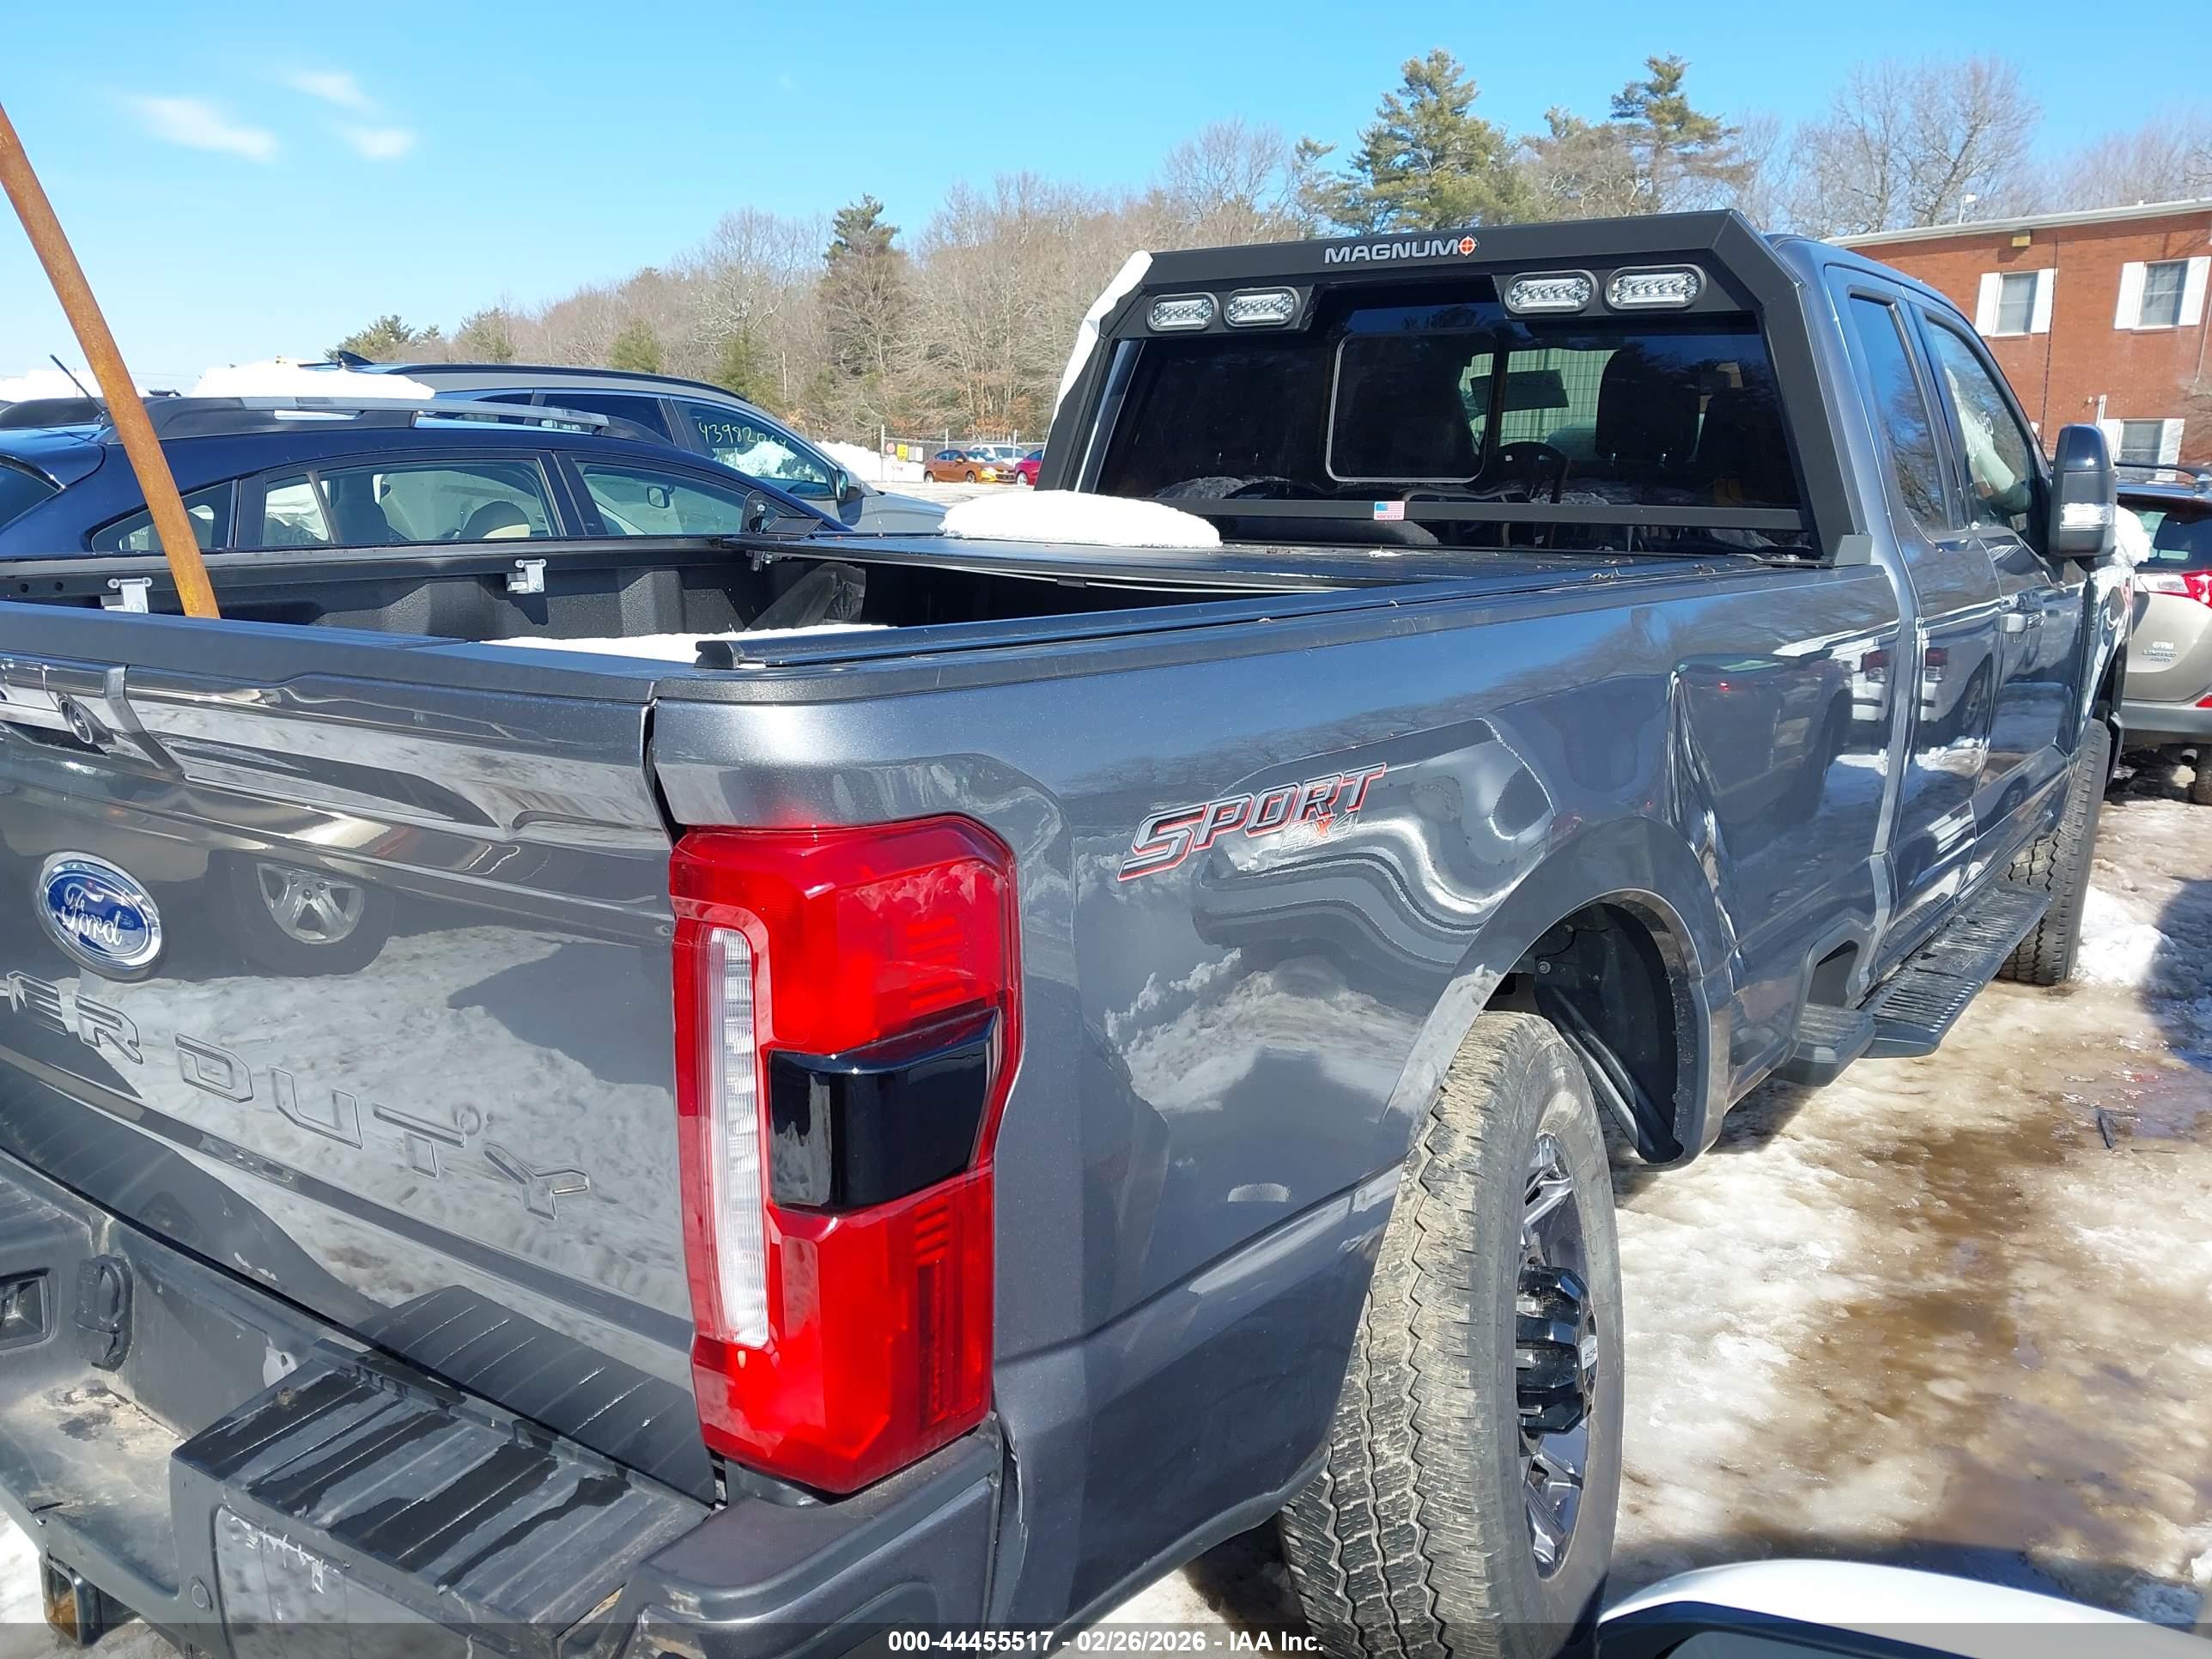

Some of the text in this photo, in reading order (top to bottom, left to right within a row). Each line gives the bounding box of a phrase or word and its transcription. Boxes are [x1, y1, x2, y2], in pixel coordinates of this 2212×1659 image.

[1323, 238, 1459, 264] MAGNUM
[1116, 762, 1388, 883] SPORT
[61, 882, 124, 946] Ford
[174, 1032, 591, 1222] DUTY
